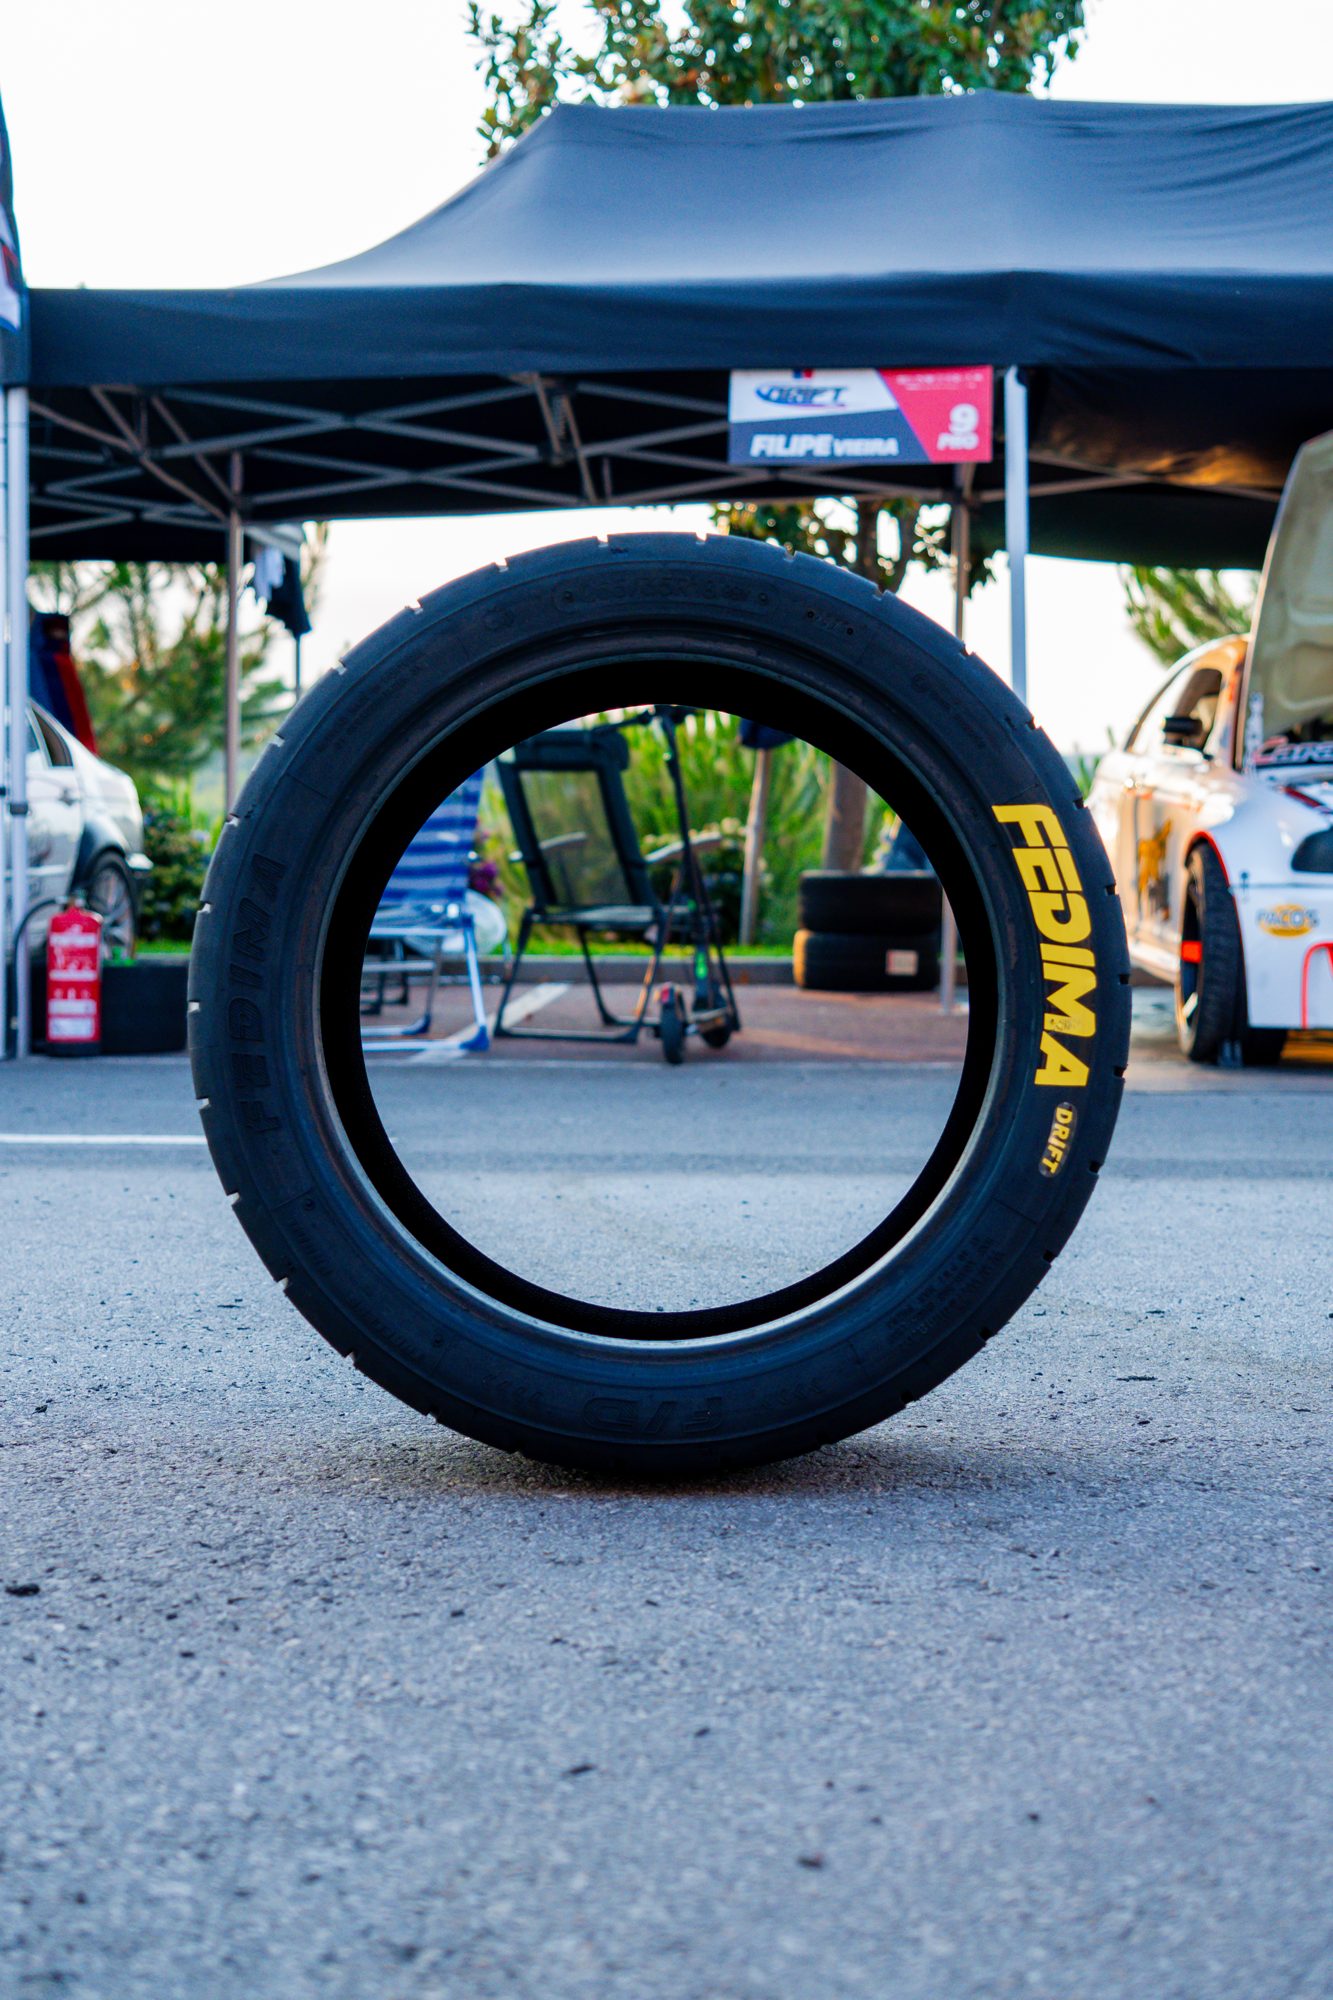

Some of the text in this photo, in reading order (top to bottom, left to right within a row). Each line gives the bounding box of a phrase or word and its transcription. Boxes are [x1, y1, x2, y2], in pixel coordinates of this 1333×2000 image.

[750, 433, 834, 458] FILIPE
[949, 403, 978, 433] 9
[992, 804, 1097, 1087] FEDIMA
[228, 852, 288, 1133] FEDIMA
[1040, 1105, 1073, 1176] DRIFT
